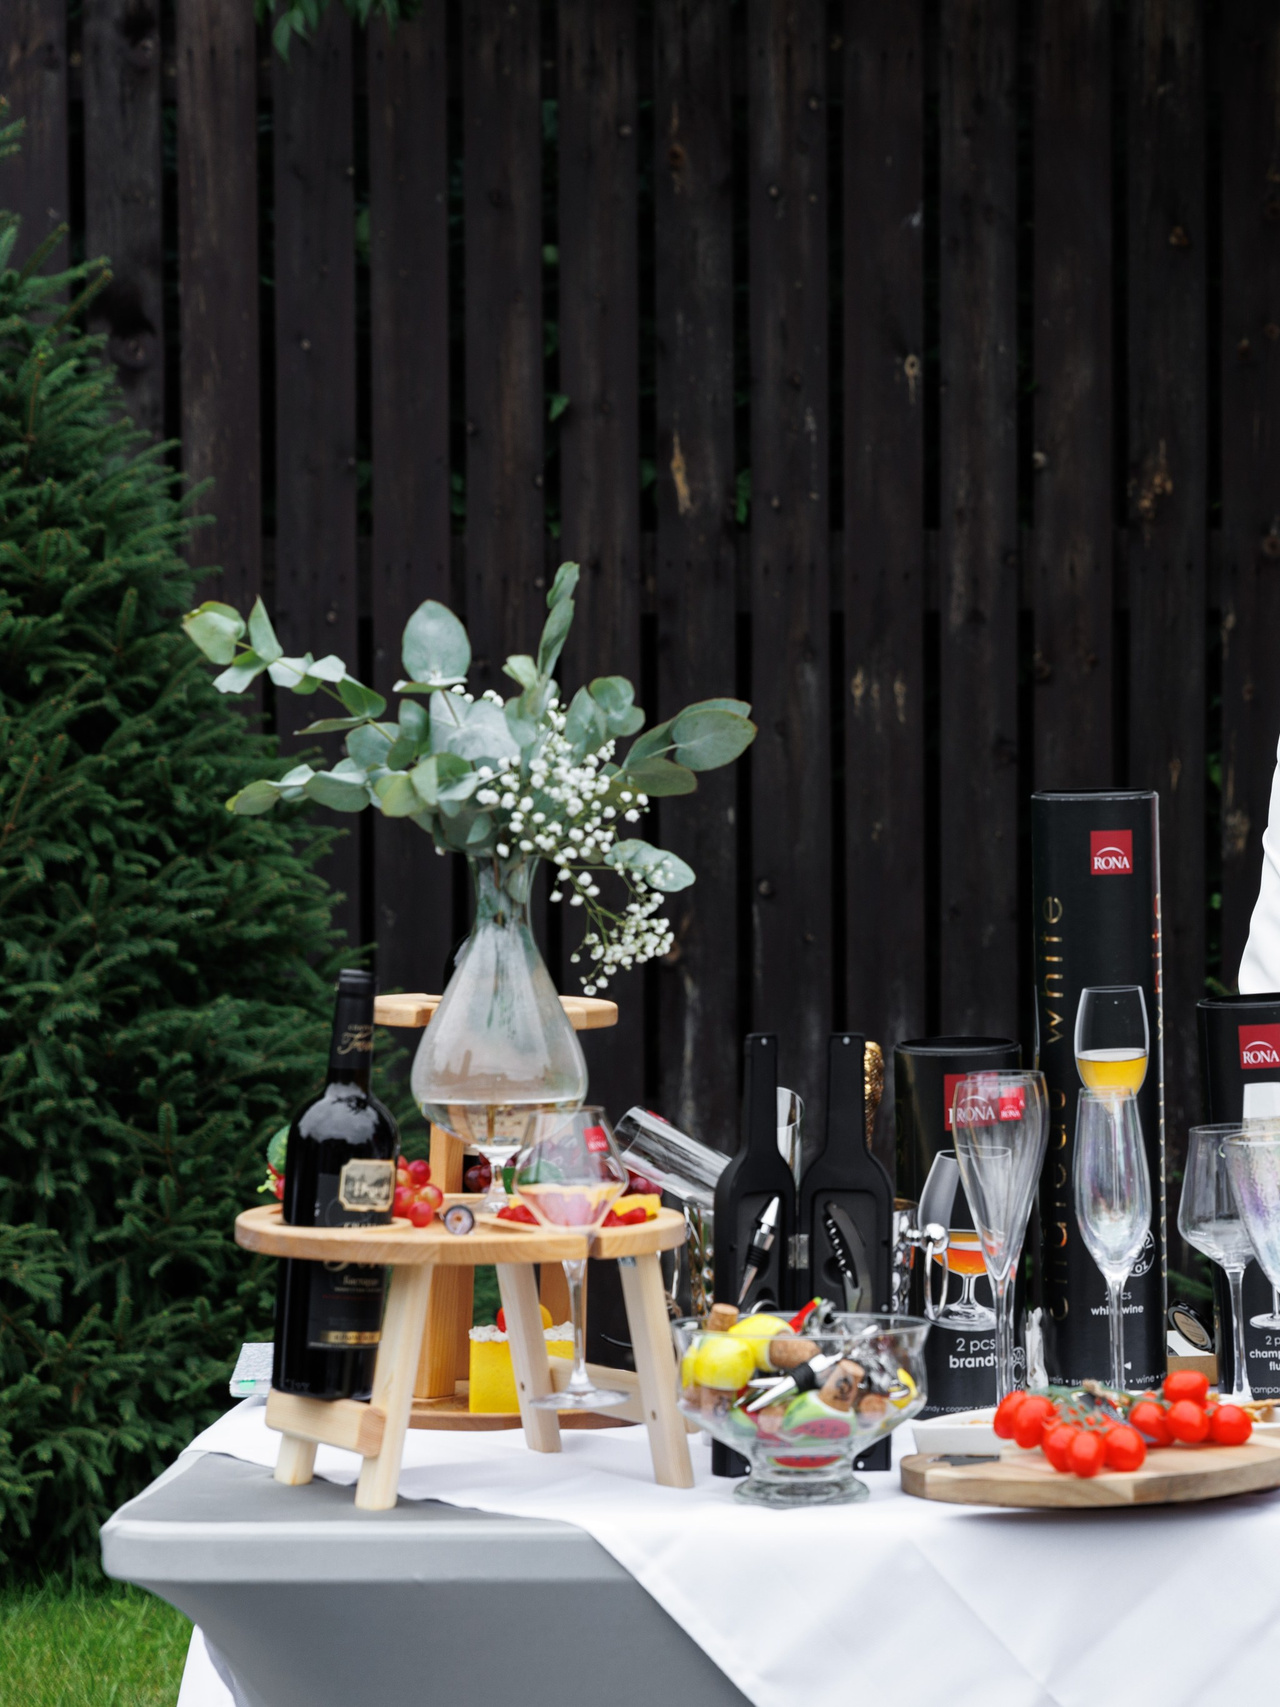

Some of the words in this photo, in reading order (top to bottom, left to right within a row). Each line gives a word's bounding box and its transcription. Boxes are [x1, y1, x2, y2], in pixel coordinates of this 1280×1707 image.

[1093, 855, 1130, 870] RONA
[1039, 895, 1064, 1045] white
[1242, 1049, 1280, 1065] RONA
[948, 1105, 996, 1124] RONA
[1000, 1108, 1021, 1118] RONA
[1121, 1304, 1145, 1315] wine
[955, 1337, 966, 1352] 2
[969, 1338, 996, 1354] pcs
[1265, 1335, 1273, 1346] 2
[1136, 1374, 1155, 1385] wine
[923, 1405, 941, 1413] andy
